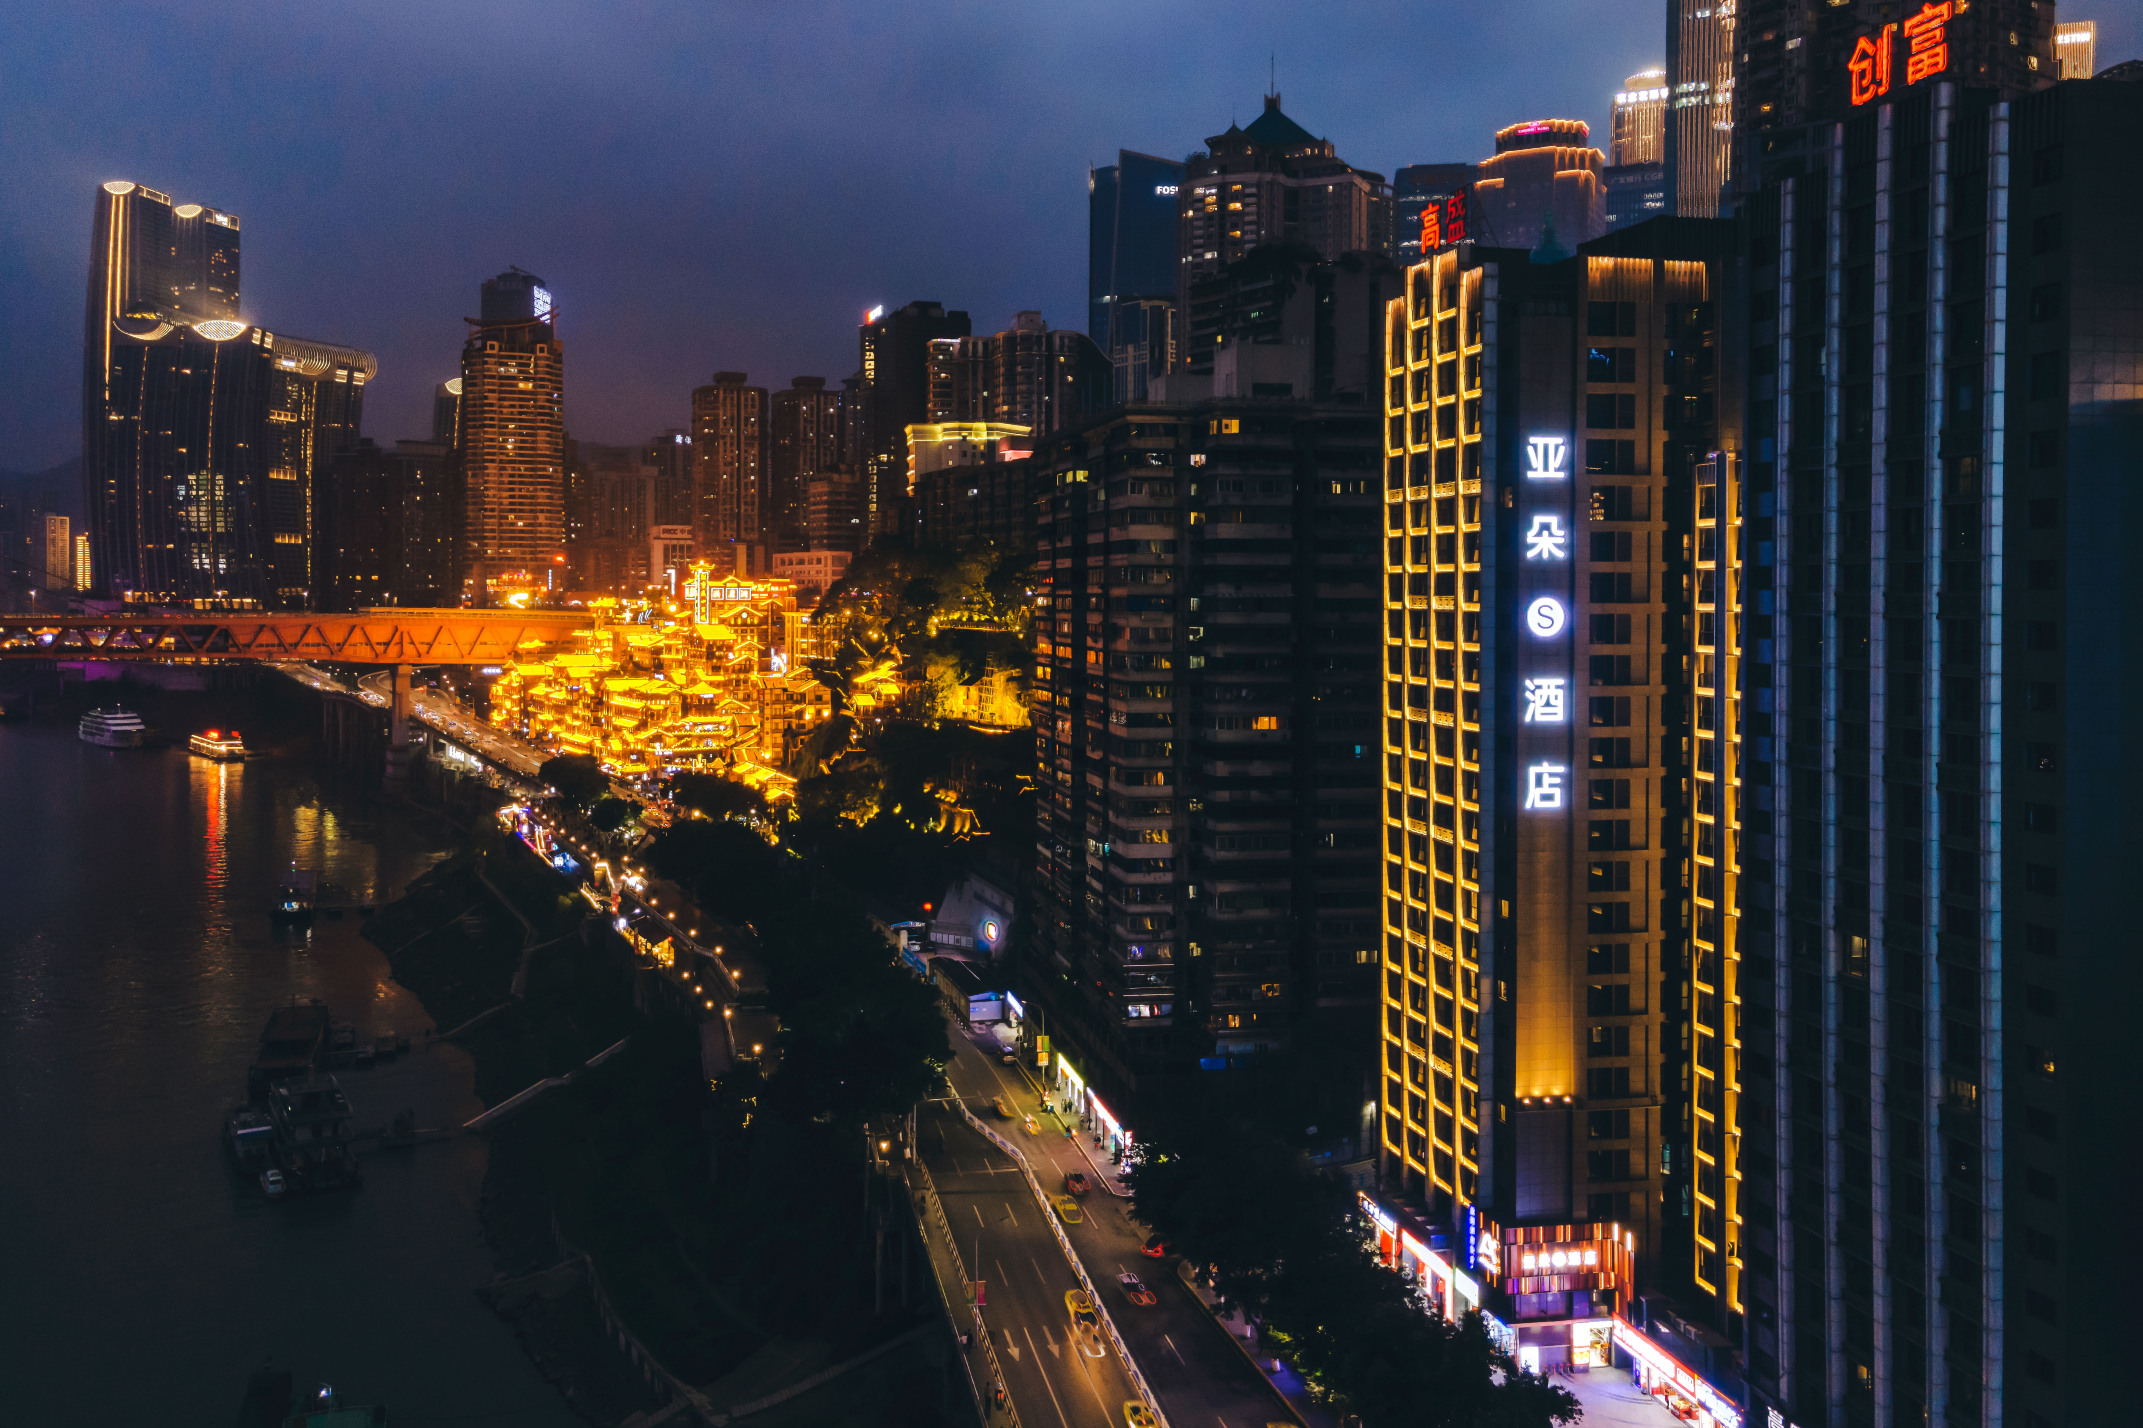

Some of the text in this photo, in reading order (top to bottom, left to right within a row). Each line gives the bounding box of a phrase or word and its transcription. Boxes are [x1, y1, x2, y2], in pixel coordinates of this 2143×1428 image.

[1847, 1, 1952, 105] 创富
[1645, 172, 1664, 180] CGB
[1420, 189, 1466, 254] 高盛
